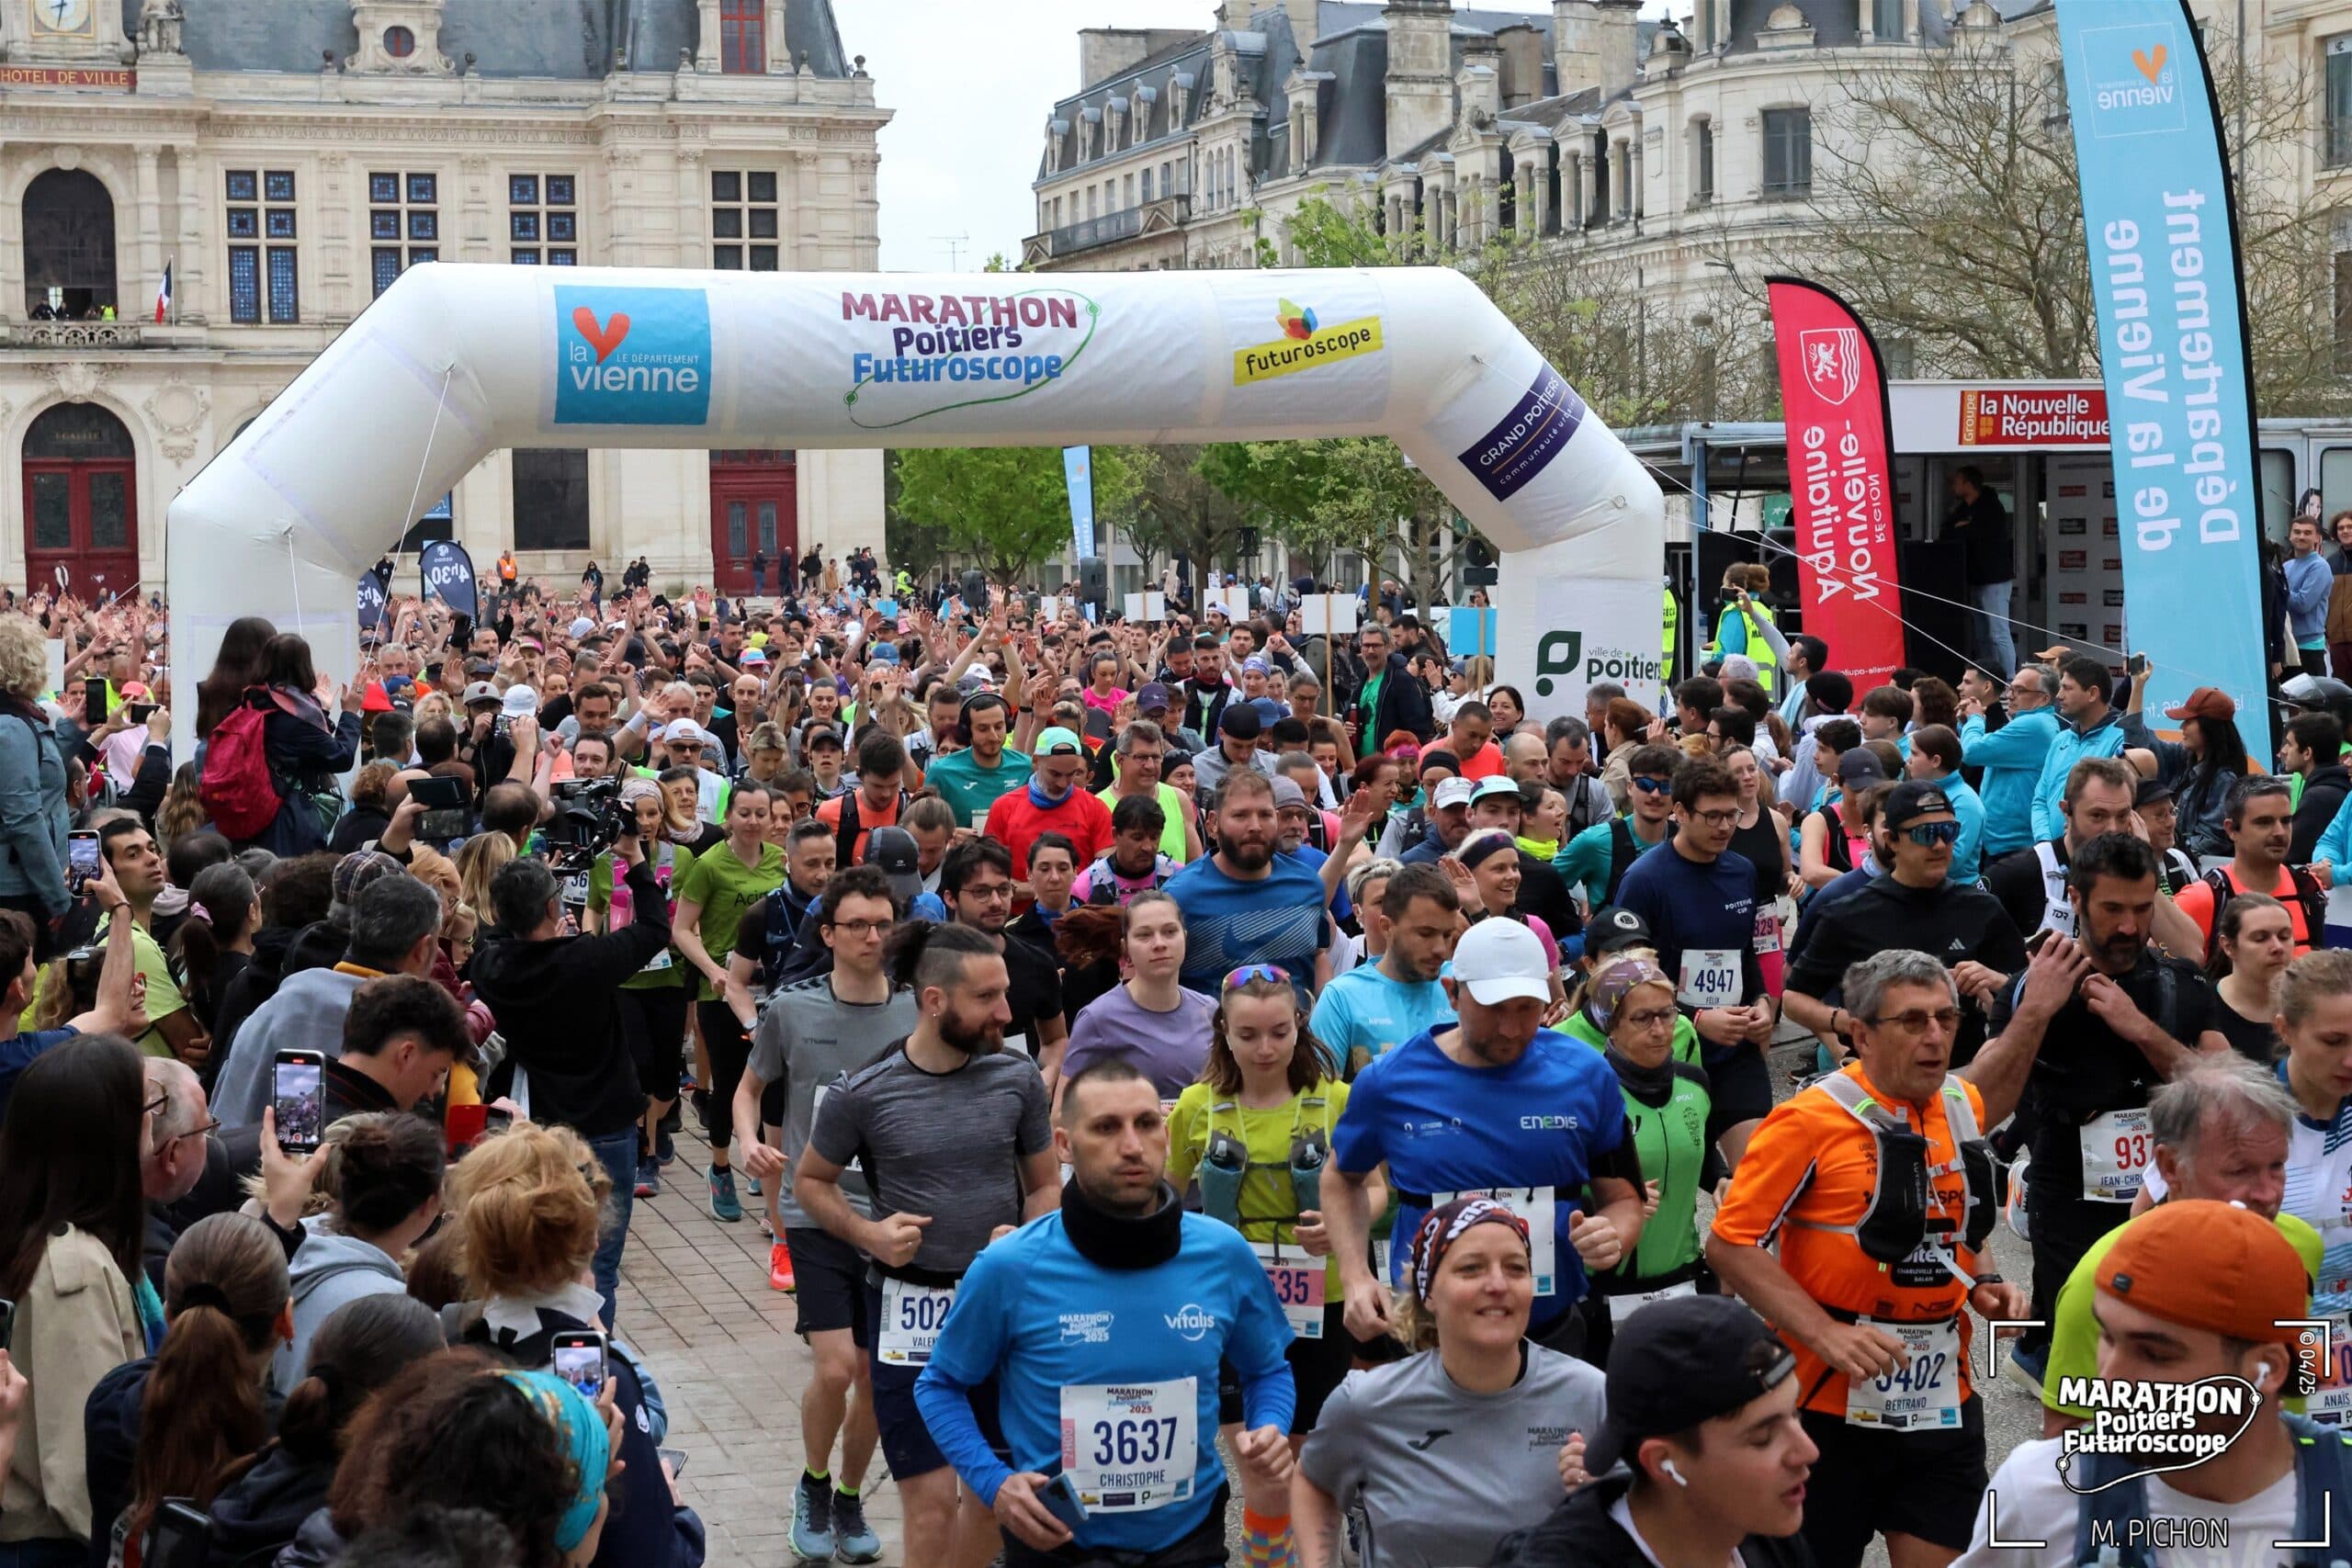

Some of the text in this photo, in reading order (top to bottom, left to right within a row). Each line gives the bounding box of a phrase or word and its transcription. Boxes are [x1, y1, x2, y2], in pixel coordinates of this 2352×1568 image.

[0, 70, 129, 85] HOTEL DE VILLE
[842, 291, 1077, 329] MARATHON
[893, 322, 1023, 357] Poitiers
[570, 341, 588, 363] la
[616, 352, 700, 365] LE DÉPARTEMENT
[1246, 328, 1371, 376] futuroscope
[571, 365, 699, 393] vienne
[853, 353, 1062, 385] Futuroscope
[1980, 394, 2089, 415] la Nouvelle
[1479, 377, 1560, 466] GRAND POITIERS
[1963, 393, 1977, 442] Groupe
[2001, 415, 2110, 441] République
[1499, 427, 1559, 485] communauté
[1588, 647, 1623, 658] ville de
[1694, 968, 1734, 993] 4947
[2114, 1111, 2147, 1120] MARATHON
[900, 1296, 951, 1331] 502
[1058, 1314, 1110, 1324] MARATHON
[1084, 1333, 1110, 1343] 2025
[1896, 1327, 1933, 1336] MARATHON
[1913, 1343, 1930, 1351] 2025
[1106, 1387, 1154, 1396] MARATHON
[1129, 1405, 1153, 1414] 2025
[1885, 1396, 1927, 1411] BERTRAND
[1093, 1416, 1178, 1466] 3637
[1100, 1470, 1165, 1487] CHRISTOPHE
